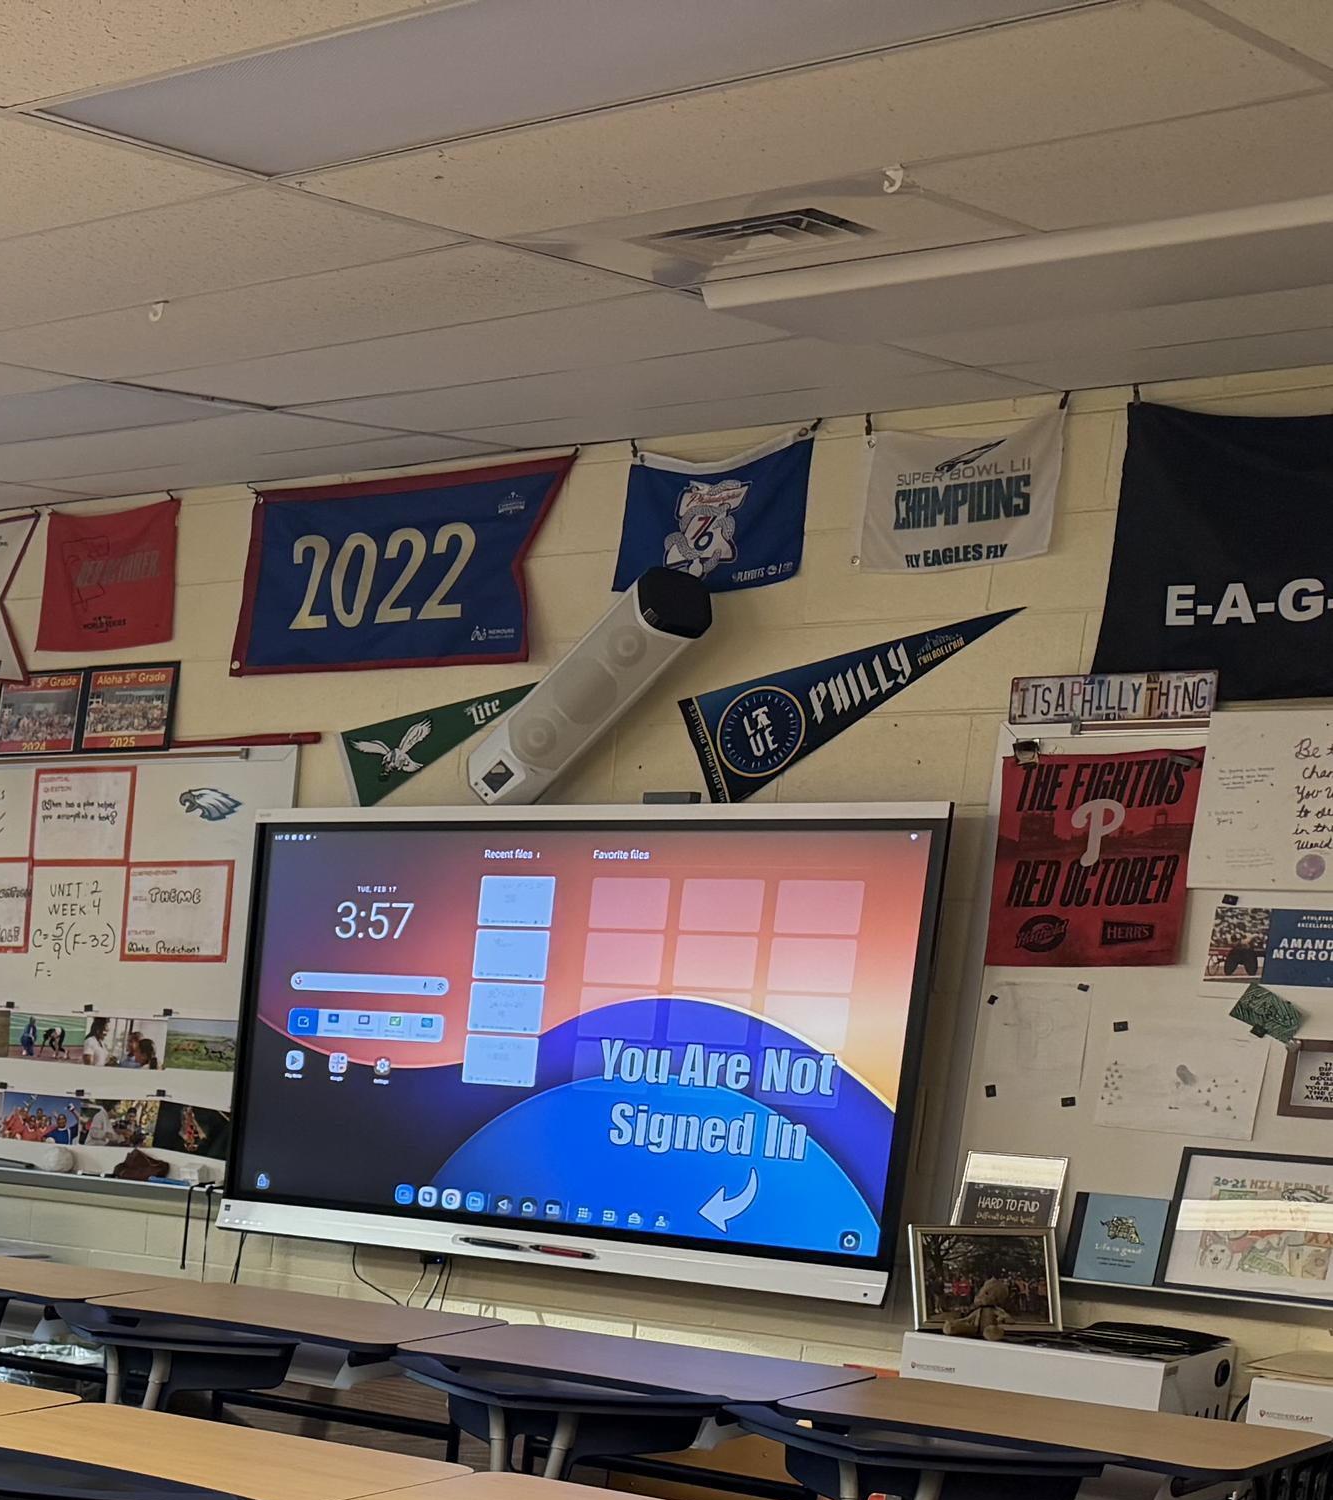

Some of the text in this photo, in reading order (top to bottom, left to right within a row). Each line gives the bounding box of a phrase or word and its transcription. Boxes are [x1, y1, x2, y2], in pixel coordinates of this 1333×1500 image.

[895, 457, 1032, 487] SUPER BOWL LII
[893, 474, 1031, 531] CHAMPIONS
[905, 543, 1009, 568] FLY EAGLES FLY
[288, 521, 477, 630] 2022
[49, 675, 77, 688] Grade
[97, 675, 123, 687] Aloha
[138, 672, 166, 684] Grade
[808, 642, 912, 726] PHILLY
[467, 698, 501, 726] Lite
[109, 736, 136, 748] 2025
[1294, 737, 1321, 760] Be
[1016, 764, 1069, 812] THE
[1066, 758, 1191, 811] FIGHTINS
[484, 848, 533, 860] Recent files
[592, 849, 650, 861] Favorite files
[90, 880, 103, 895] 2
[357, 885, 372, 894] TUE,
[373, 885, 387, 893] FEB
[1006, 859, 1062, 908] RED
[1059, 854, 1180, 908] OCTOBER
[48, 898, 101, 916] WEEK 4
[149, 887, 202, 905] THEME
[335, 900, 414, 940] 3:57
[600, 1038, 837, 1096] You Are Not
[608, 1101, 808, 1162] Signed In
[977, 1195, 1040, 1213] HARD TO FIND
[1120, 1248, 1143, 1257] good
